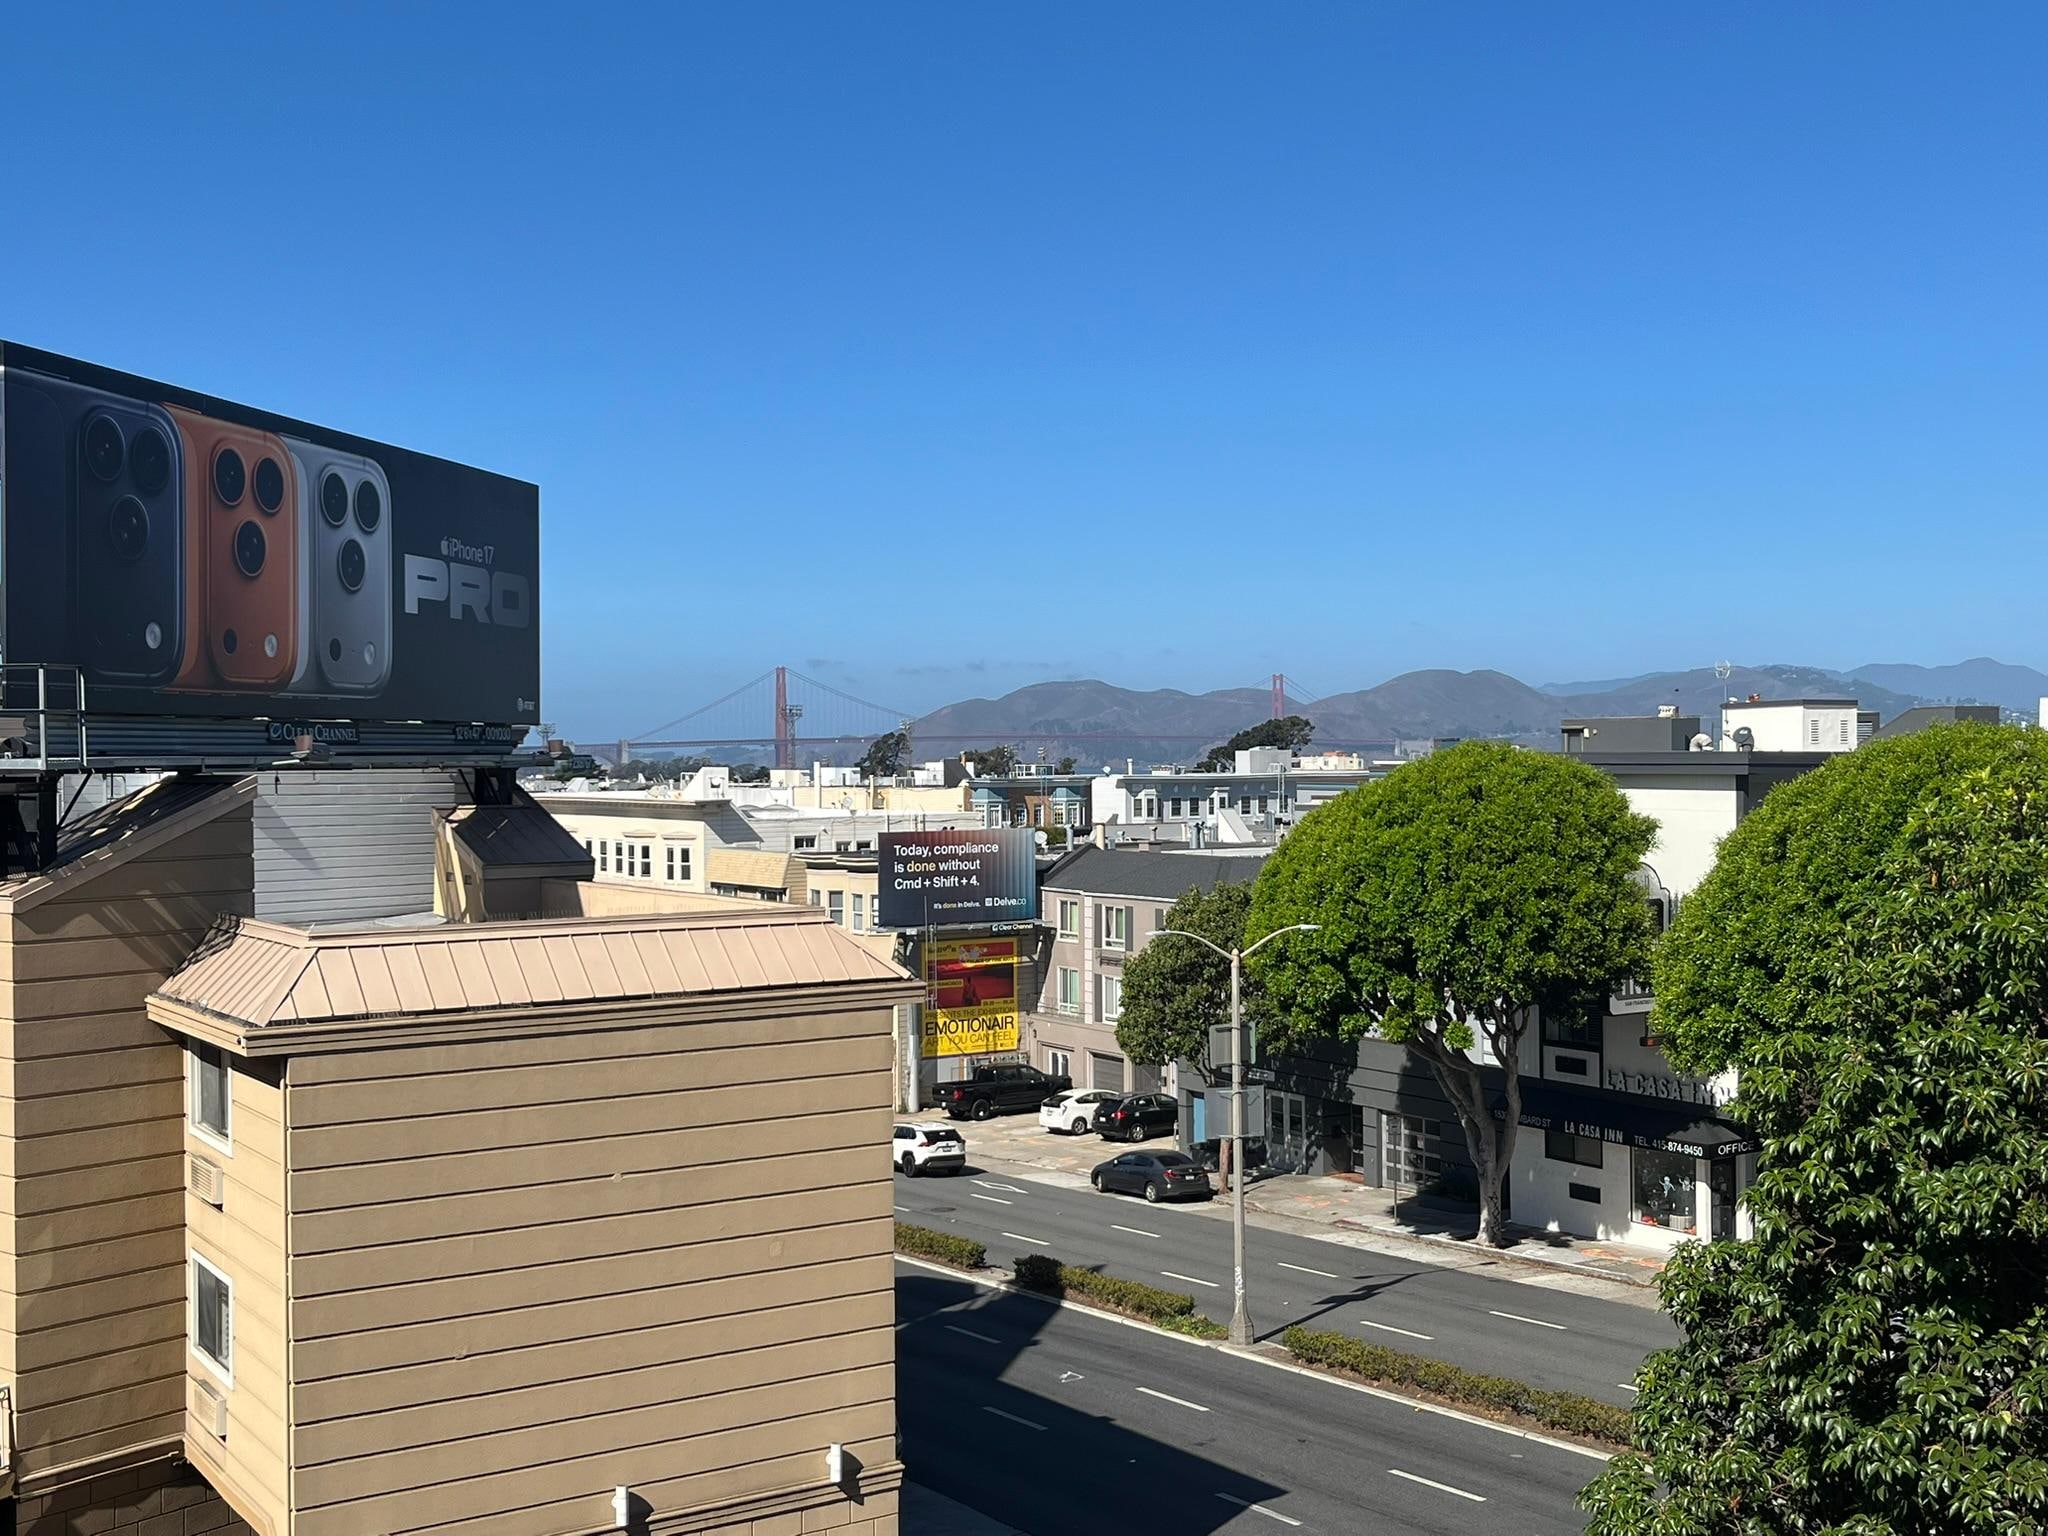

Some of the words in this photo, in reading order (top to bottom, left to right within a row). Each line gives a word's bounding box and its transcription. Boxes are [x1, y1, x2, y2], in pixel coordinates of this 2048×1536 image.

[449, 537, 483, 562] iPhone
[484, 546, 494, 564] 17
[404, 553, 530, 629] PRO
[315, 724, 359, 741] CHANNEL
[894, 844, 932, 857] Today,
[934, 842, 999, 856] compliance
[894, 861, 904, 873] is
[907, 860, 936, 873] done
[939, 859, 981, 871] without
[894, 877, 921, 890] Cmd
[924, 880, 931, 888] +
[933, 876, 959, 888] Shift
[960, 879, 968, 887] +
[970, 875, 980, 886] 4.
[963, 1008, 976, 1017] THE
[925, 1015, 1014, 1036] EMOTIONAIR
[925, 1036, 945, 1047] ART
[969, 1032, 989, 1044] CAN
[993, 1030, 1014, 1042] FEEL
[1603, 1069, 1627, 1091] LA
[1635, 1073, 1683, 1100] CASA
[1691, 1081, 1732, 1106] INN
[1542, 1118, 1551, 1127] ST
[1564, 1120, 1575, 1134] LA
[1579, 1123, 1600, 1139] CASA
[1604, 1127, 1623, 1143] INN
[1651, 1138, 1703, 1157] 415-874-9450
